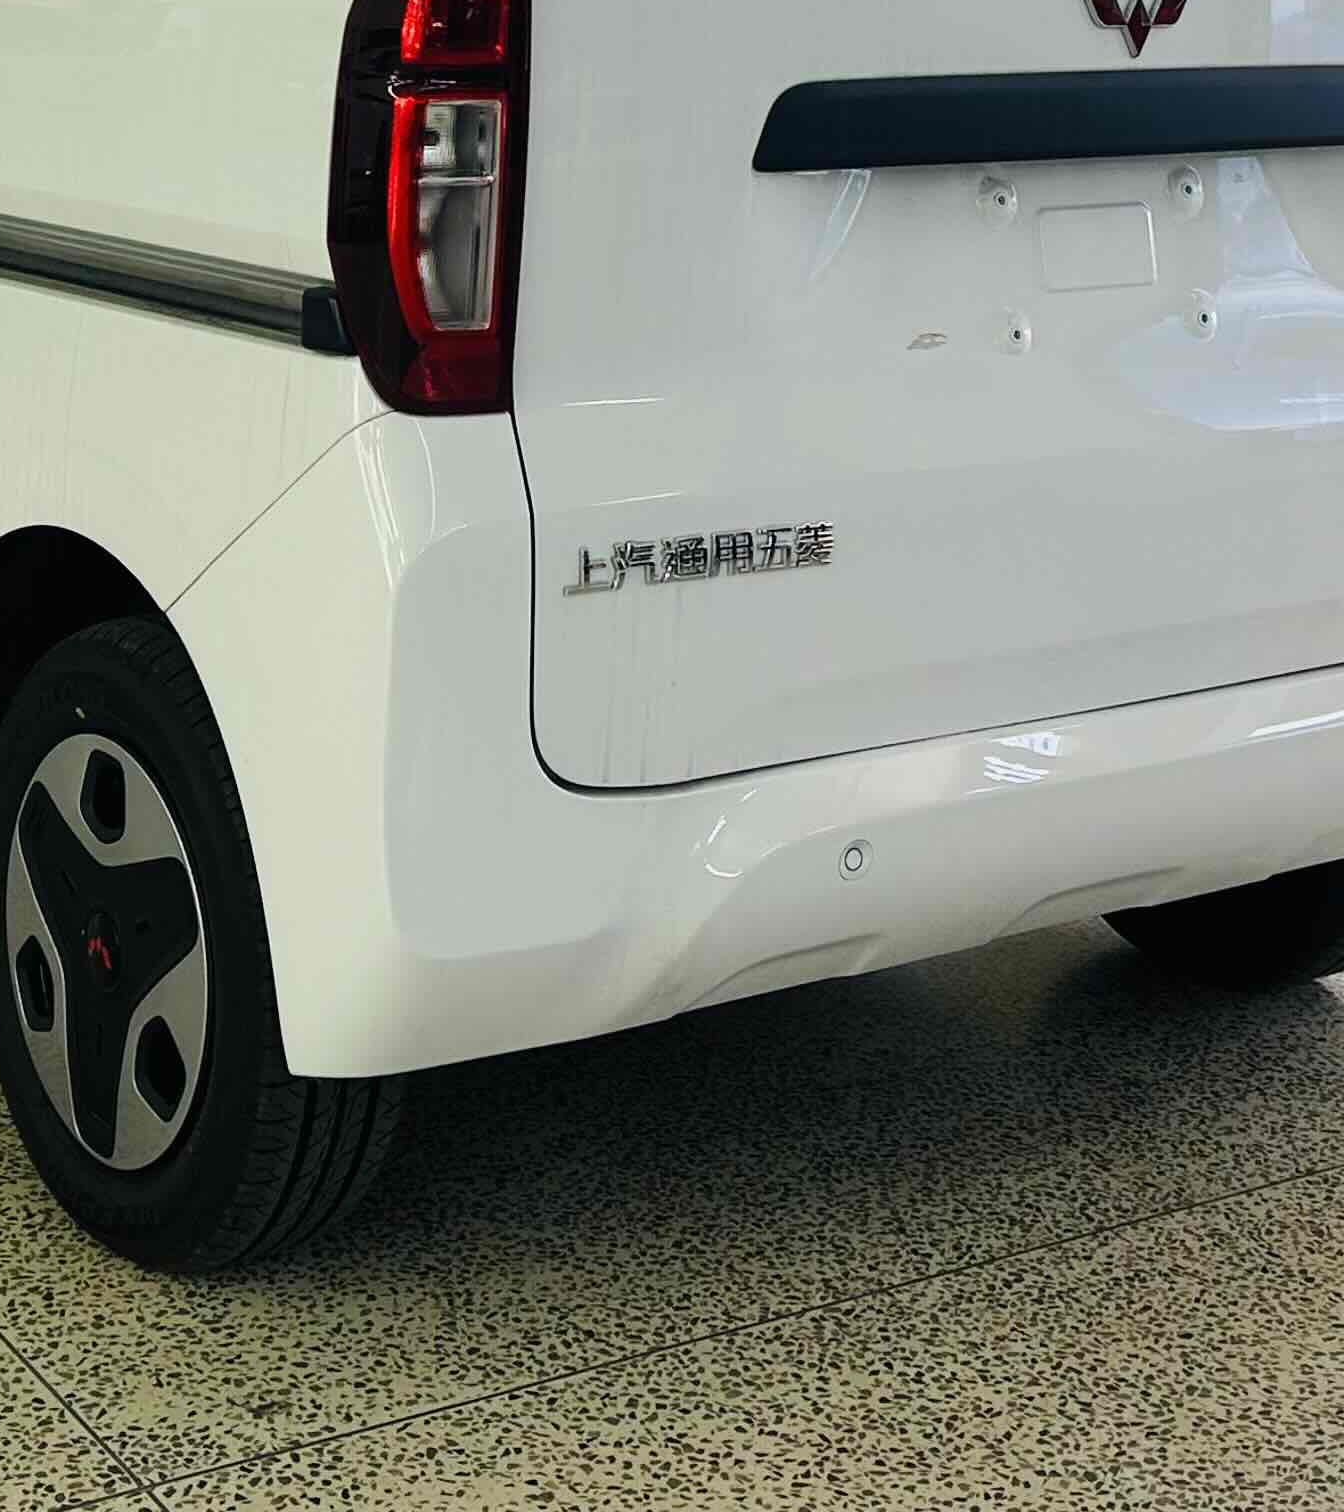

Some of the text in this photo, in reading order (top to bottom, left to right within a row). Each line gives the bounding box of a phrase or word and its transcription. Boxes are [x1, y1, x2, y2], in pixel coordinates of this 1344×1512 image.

[562, 520, 835, 597] 上汽通用五菱
